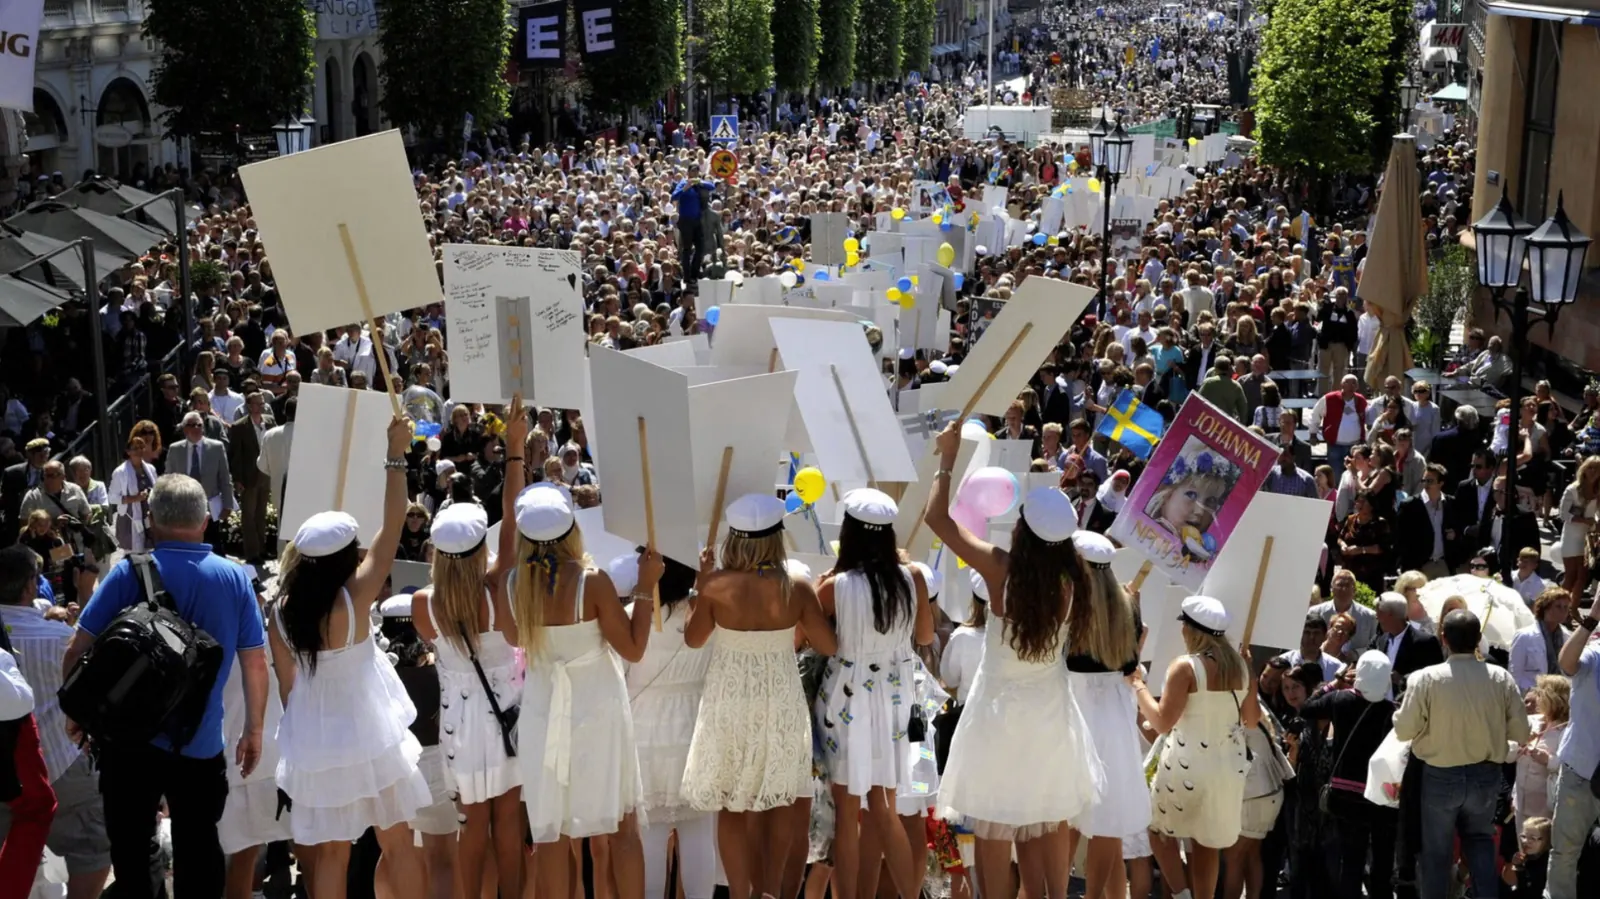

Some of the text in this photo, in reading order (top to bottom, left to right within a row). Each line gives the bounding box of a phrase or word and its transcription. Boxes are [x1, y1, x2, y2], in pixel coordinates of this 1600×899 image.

[526, 16, 560, 58] E
[582, 8, 615, 53] E
[1433, 26, 1465, 46] H&M
[1189, 411, 1262, 469] JOHANNA
